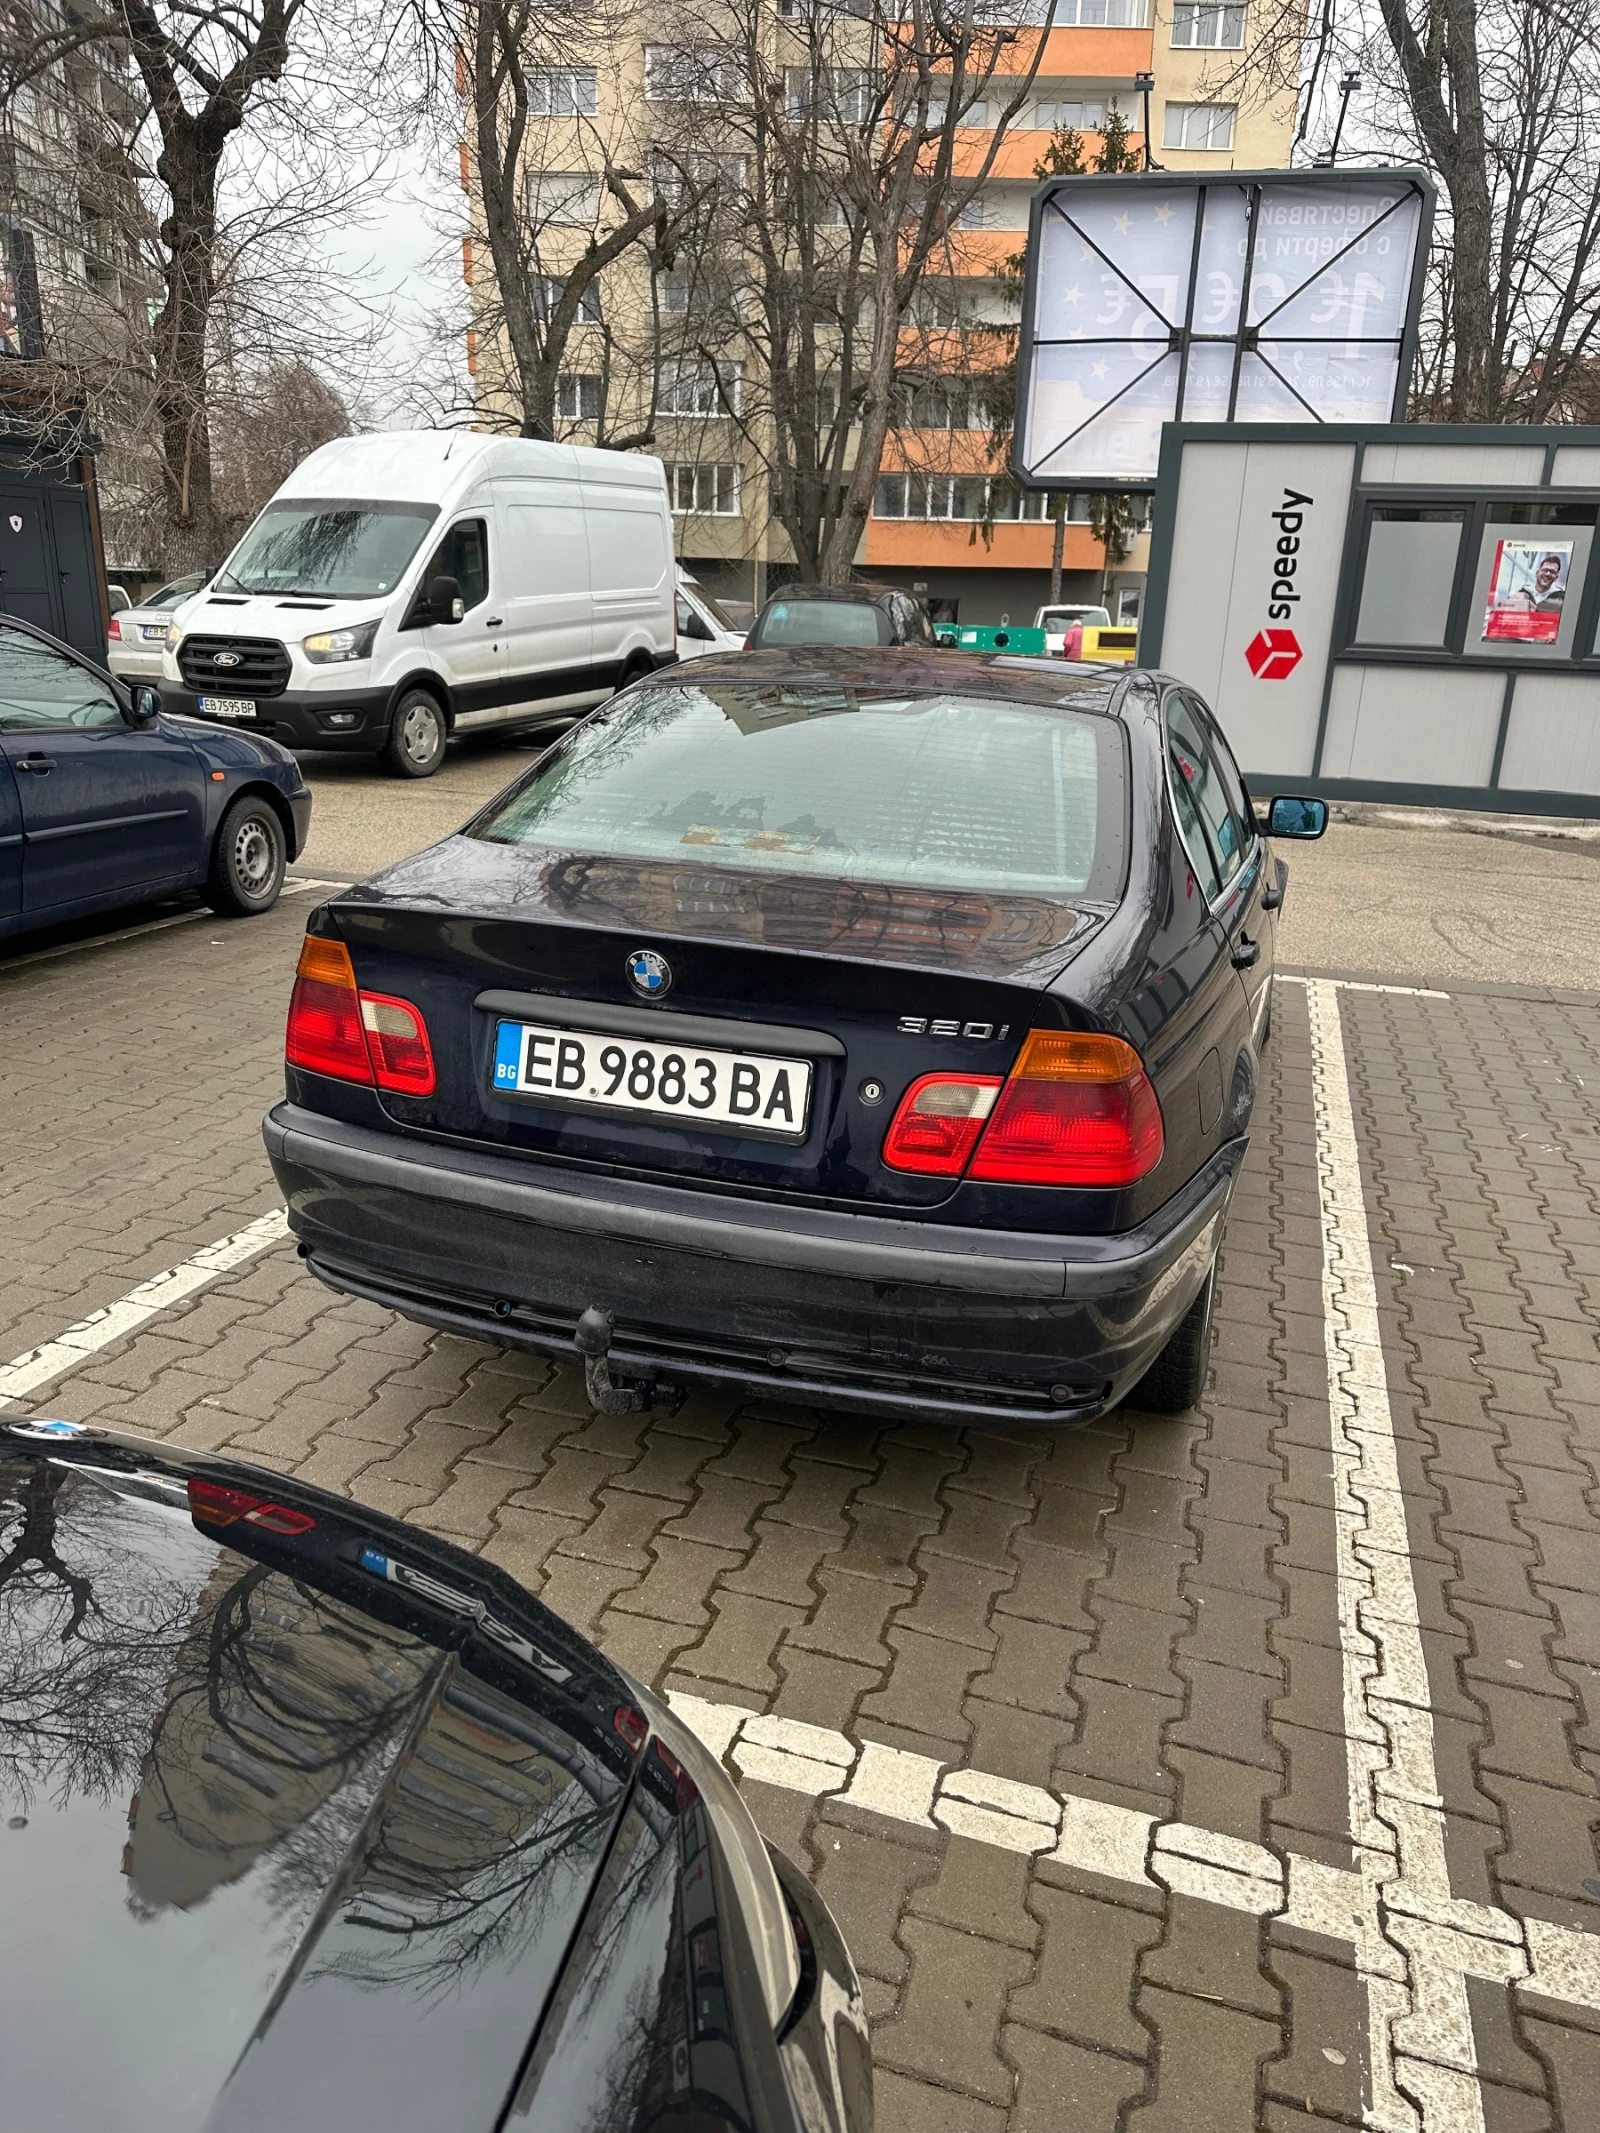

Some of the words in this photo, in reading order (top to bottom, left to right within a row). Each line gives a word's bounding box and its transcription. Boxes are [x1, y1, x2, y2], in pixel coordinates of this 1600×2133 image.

[1268, 487, 1314, 620] speedy
[204, 699, 217, 711] EB
[217, 700, 240, 713] 7595
[241, 702, 254, 714] BP
[897, 1016, 1010, 1041] 320i
[497, 1063, 516, 1079] BG
[524, 1034, 585, 1090] EB
[600, 1045, 717, 1109] 9883
[729, 1062, 793, 1123] BA
